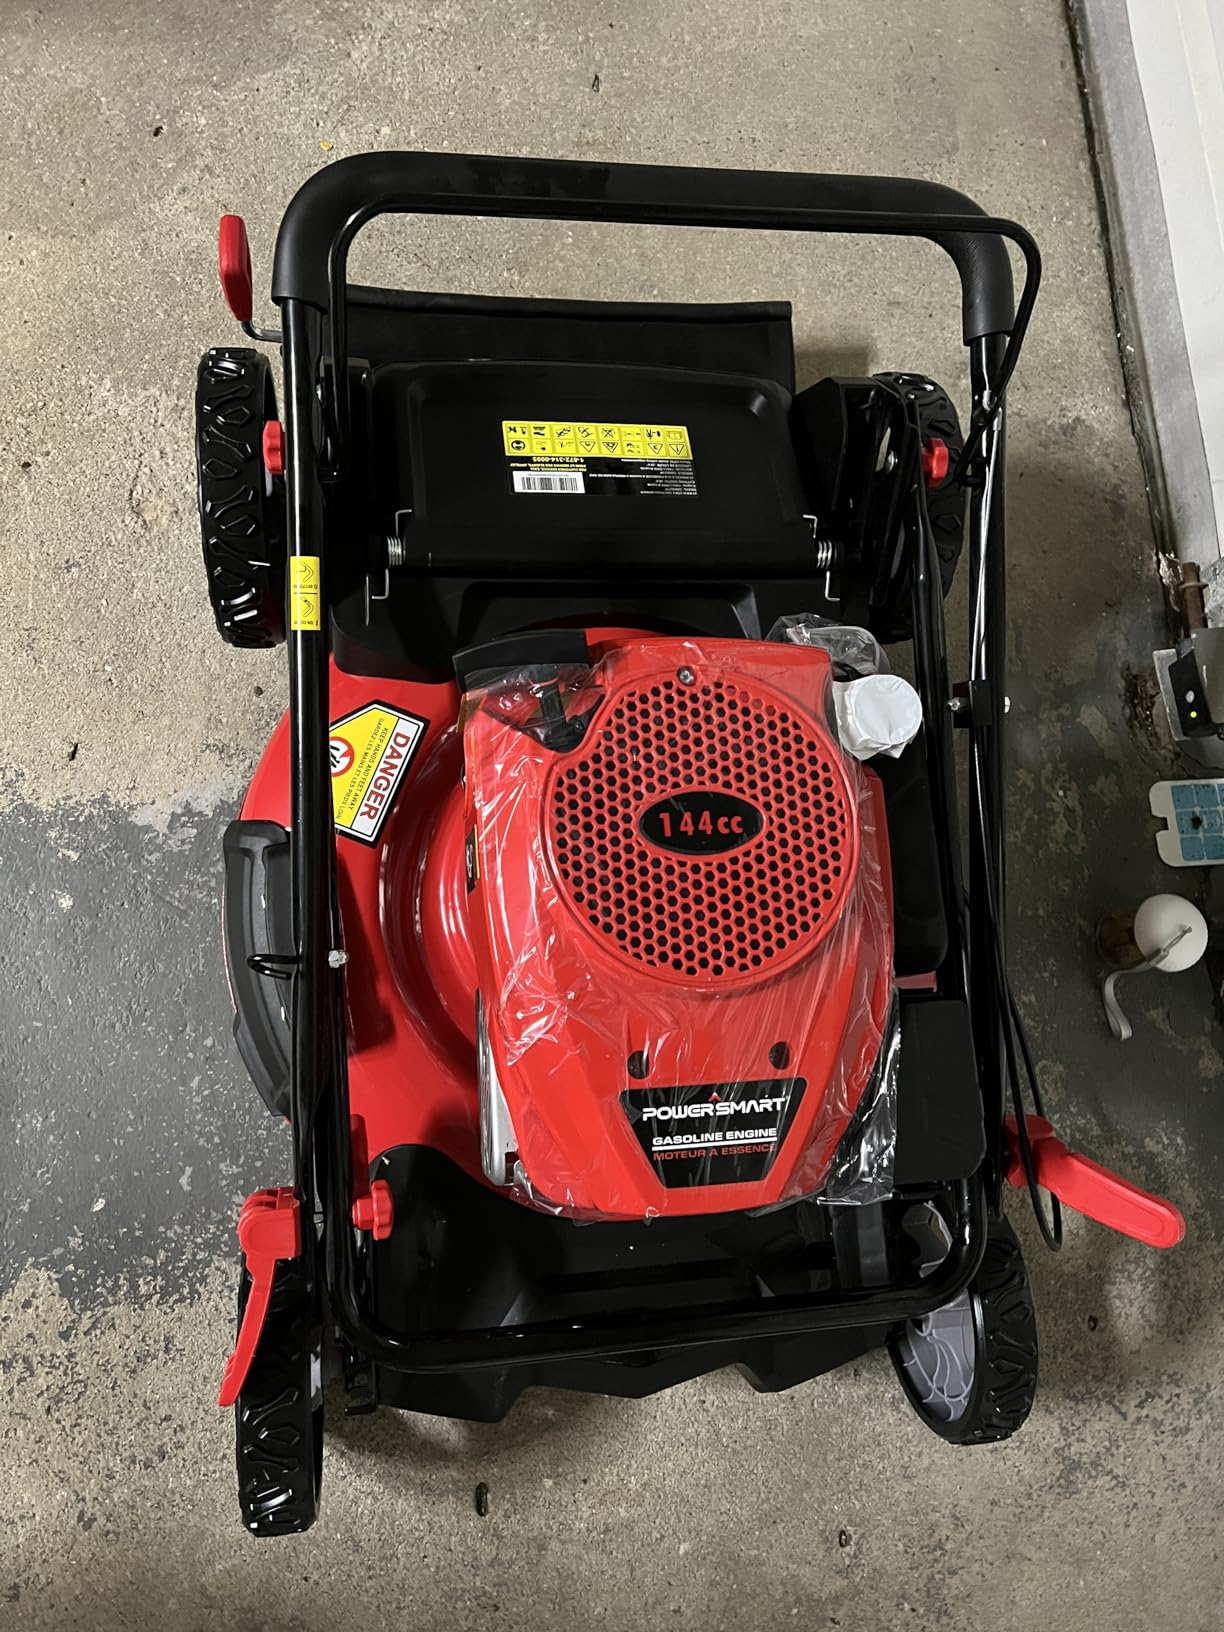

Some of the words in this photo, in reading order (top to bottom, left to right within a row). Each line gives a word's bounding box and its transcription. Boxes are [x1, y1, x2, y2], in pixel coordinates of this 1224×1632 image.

[370, 717, 384, 738] GARDEZ
[379, 728, 388, 743] KEEP
[366, 738, 375, 752] LES
[369, 745, 382, 763] HANDS
[358, 751, 369, 769] MAINS
[355, 768, 361, 777] ET
[360, 732, 411, 820] DANGER
[364, 765, 373, 777] AND
[350, 776, 358, 788] LES
[357, 778, 367, 792] FEET
[343, 788, 353, 806] PIEDS
[348, 793, 359, 811] AWAY
[335, 804, 346, 819] LOIN
[659, 810, 744, 837] 144cc
[642, 1097, 785, 1121] POWERSMART
[652, 1132, 723, 1146] GASOLINE
[725, 1127, 777, 1140] ENGINE
[653, 1150, 706, 1161] MOTEUR
[721, 1143, 777, 1155] ESSENCE
